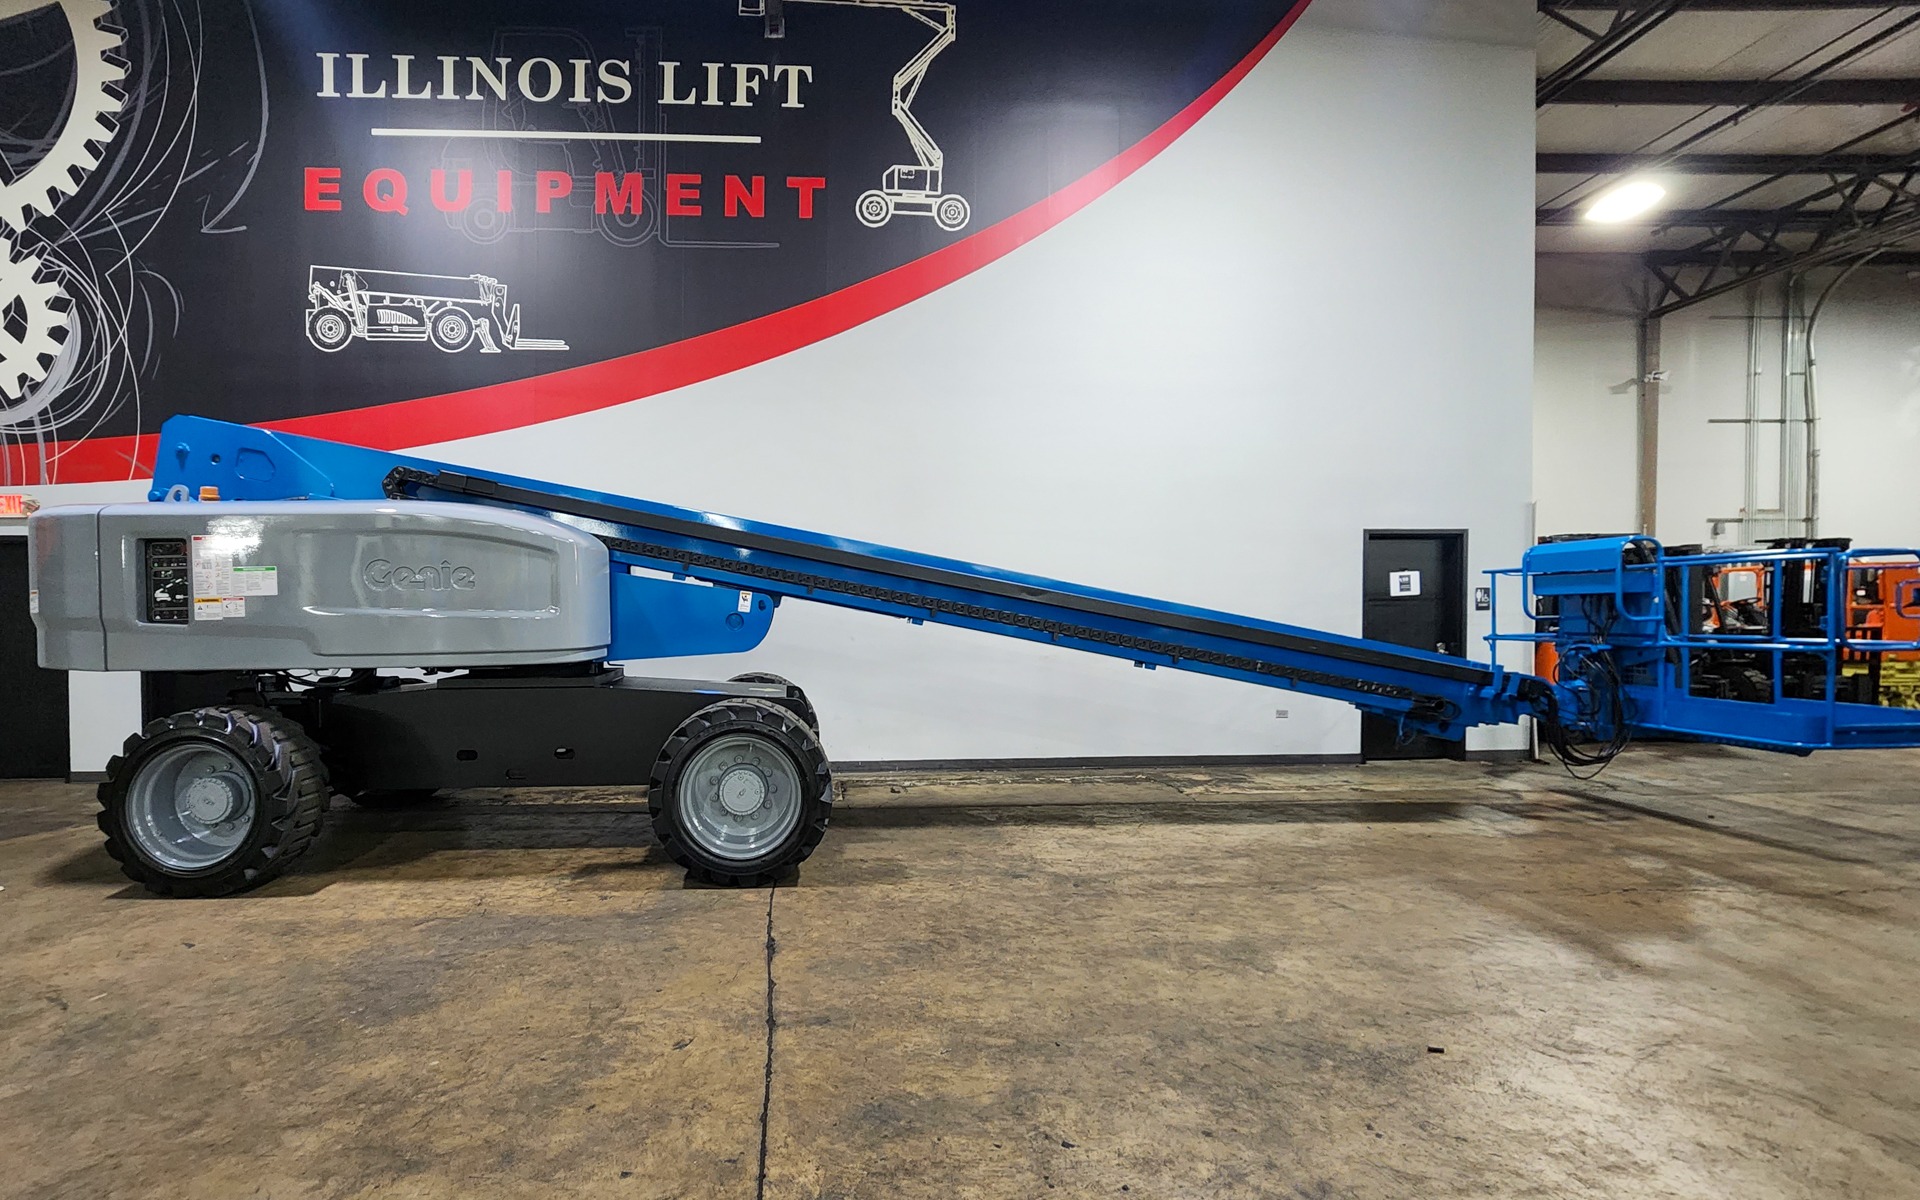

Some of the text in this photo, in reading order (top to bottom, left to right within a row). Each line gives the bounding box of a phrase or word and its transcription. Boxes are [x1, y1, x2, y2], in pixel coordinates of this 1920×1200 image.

[315, 52, 814, 109] ILLINOIS LIFT
[303, 166, 827, 219] EQUIPMENT
[363, 558, 476, 591] Genie
